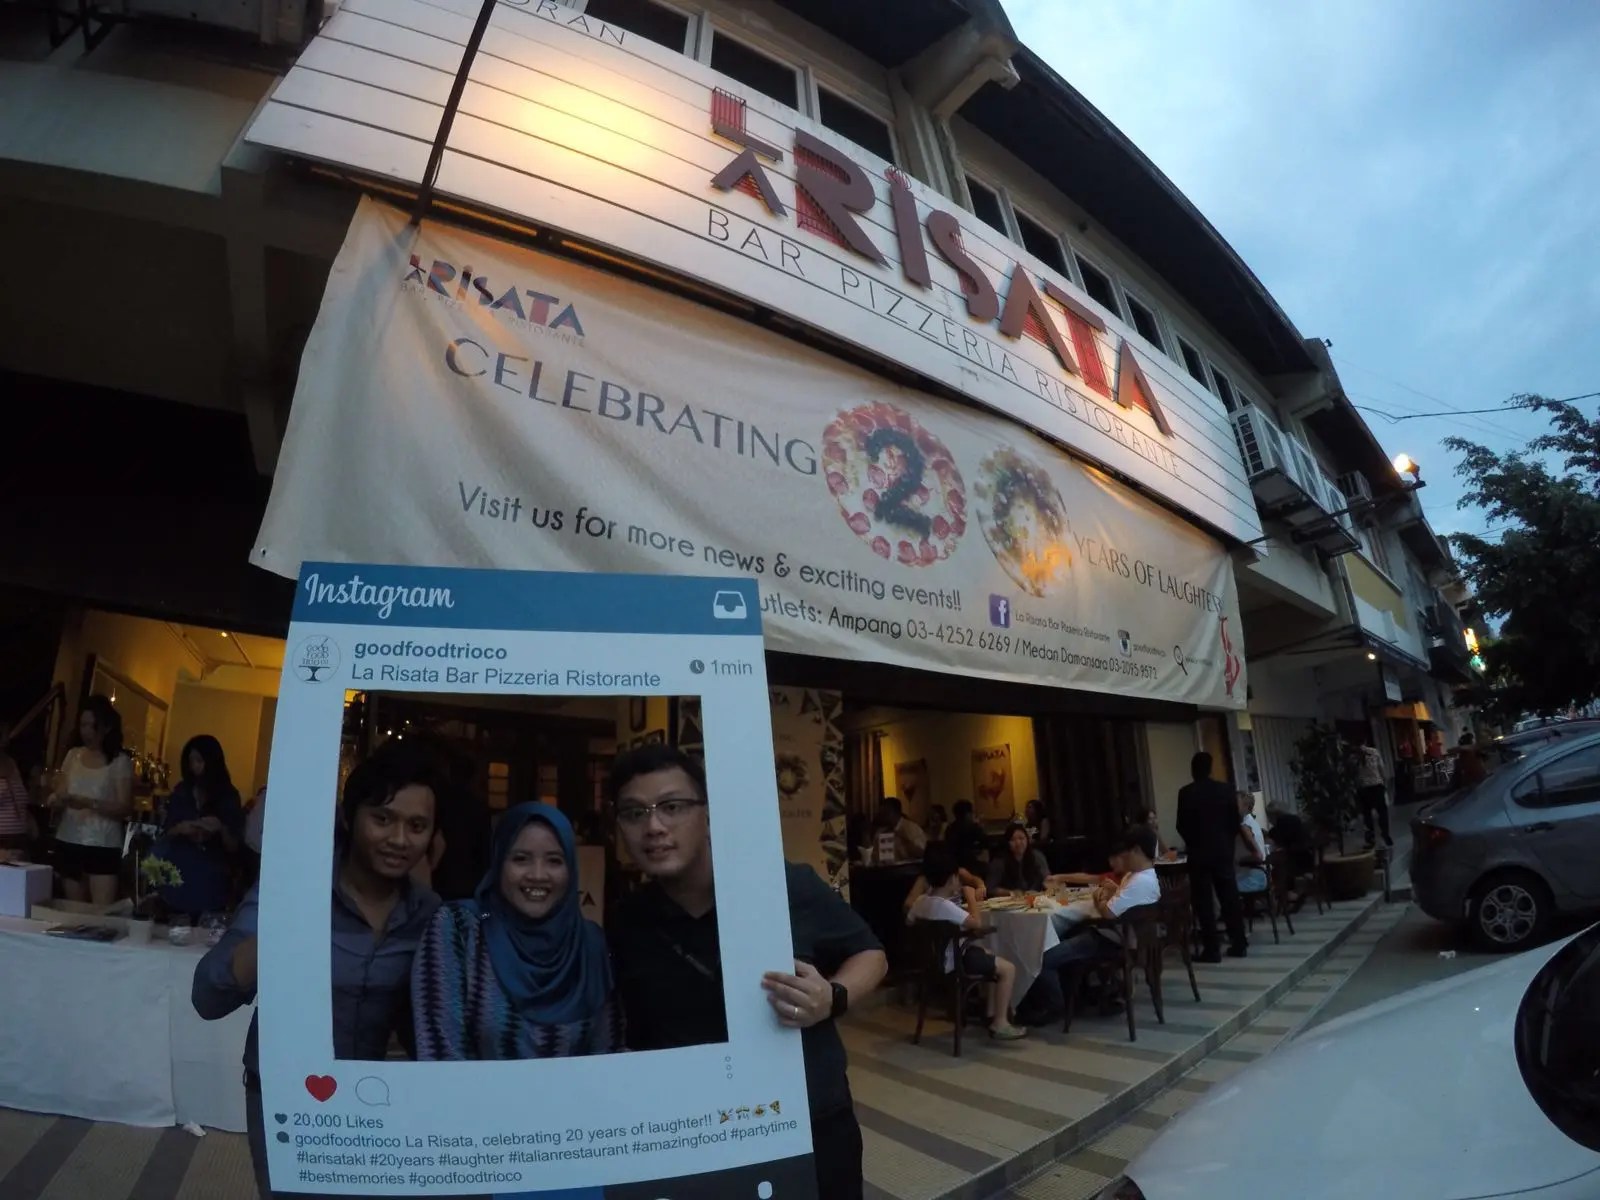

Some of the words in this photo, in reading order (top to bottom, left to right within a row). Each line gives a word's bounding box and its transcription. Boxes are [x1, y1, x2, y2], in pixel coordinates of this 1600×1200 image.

[502, 0, 625, 45] RAN
[793, 126, 1175, 438] RISATA
[707, 209, 805, 277] BAR
[842, 267, 1019, 381] PIZZERIA
[1036, 367, 1180, 479] RISTORANTE
[445, 338, 818, 476] CELEBRATING
[1073, 532, 1131, 579] YEARS
[1134, 559, 1155, 588] OF
[1158, 570, 1225, 613] LAUGHTER
[458, 481, 523, 523] Visit
[531, 506, 564, 532] us
[575, 506, 618, 540] for
[628, 523, 695, 558] more
[704, 545, 766, 575] news
[773, 552, 791, 578] &
[799, 564, 886, 600] exciting
[892, 584, 962, 612] events!!
[304, 572, 455, 620] Instagram
[354, 640, 508, 662] goodfoodtrioco
[760, 593, 823, 625] utlets:
[828, 606, 902, 640] Ampang
[906, 619, 974, 648] 03-4252
[979, 631, 1011, 654] 6269
[1022, 638, 1060, 662] Medan
[1061, 646, 1108, 672] Damansara
[351, 663, 377, 681] La
[380, 664, 444, 683] Risata
[447, 665, 480, 685] Bar
[484, 666, 561, 686] Pizzeria
[566, 668, 661, 687] Ristorante
[710, 659, 754, 676] 1min
[293, 1113, 342, 1130] 20,000
[345, 1113, 384, 1129] Likes
[294, 1132, 401, 1151] goodfoodtrioco
[405, 1135, 423, 1148] La
[427, 1134, 479, 1150] Risata,
[482, 1131, 561, 1150] celebrating
[565, 1128, 583, 1142] 20
[588, 1126, 626, 1144] years
[631, 1122, 646, 1137] of
[648, 1114, 712, 1135] laughter!!
[297, 1150, 367, 1167] #larisatakl
[370, 1153, 435, 1169] #20years
[438, 1149, 505, 1170] #laughter
[508, 1143, 629, 1163] #italianrestaurant
[632, 1131, 727, 1154] #amazingfood
[730, 1119, 798, 1141] #partytime
[299, 1170, 405, 1185] #bestmemories
[409, 1169, 522, 1186] #goodfoodtrioco
